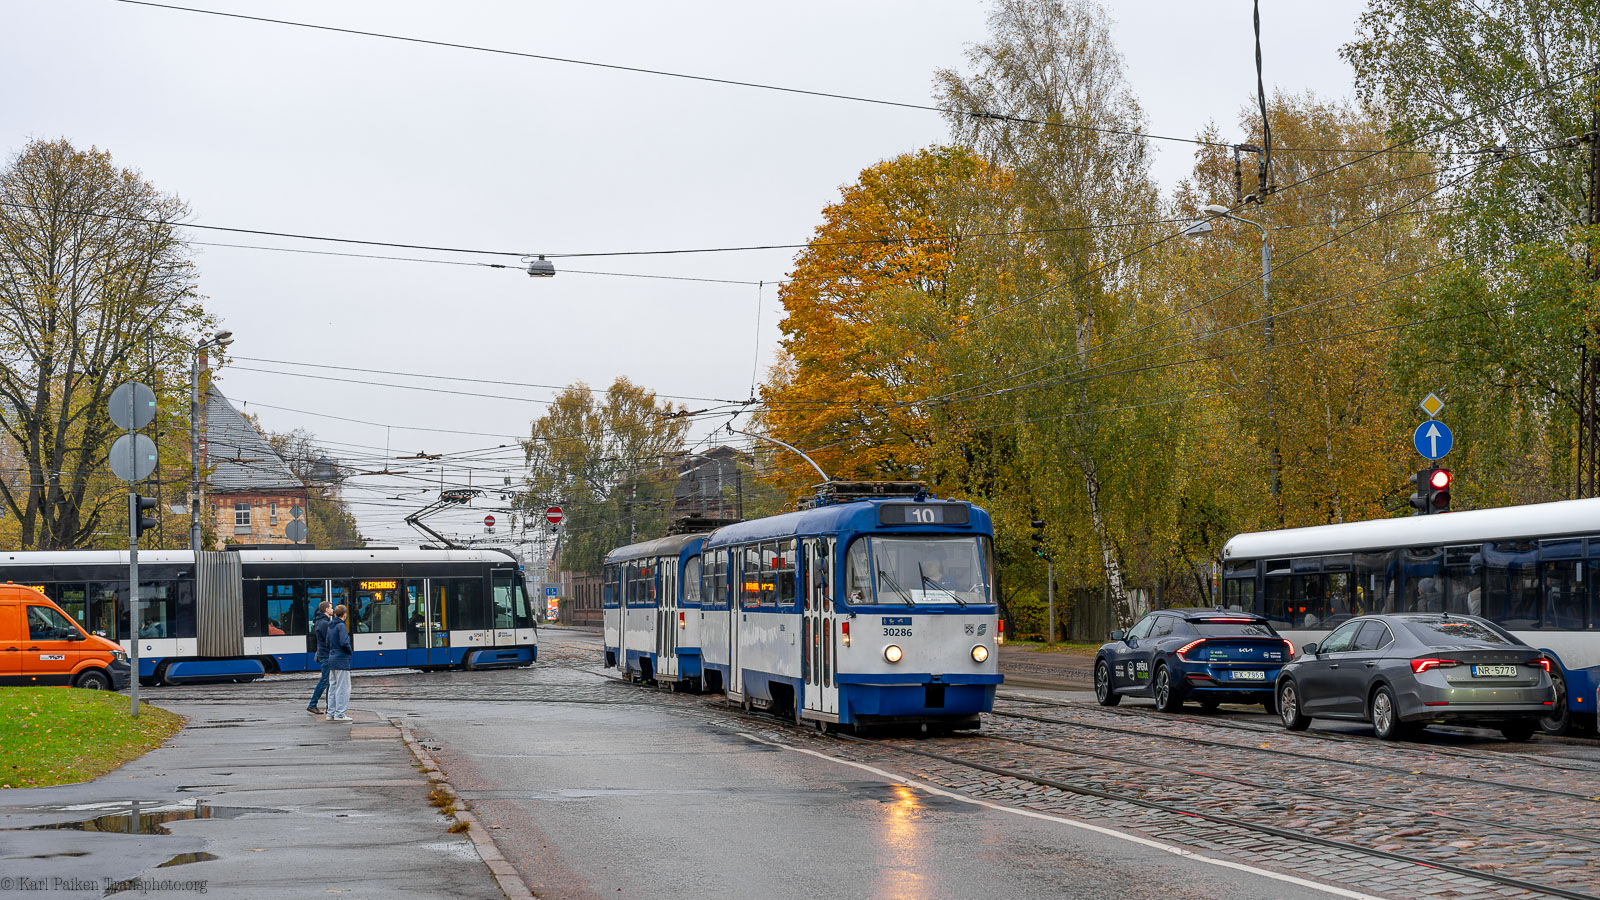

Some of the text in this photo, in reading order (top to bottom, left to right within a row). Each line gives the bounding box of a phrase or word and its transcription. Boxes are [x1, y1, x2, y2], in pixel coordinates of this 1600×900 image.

[912, 508, 935, 523] 10
[883, 628, 913, 637] 30286
[1478, 666, 1516, 675] NR-5778
